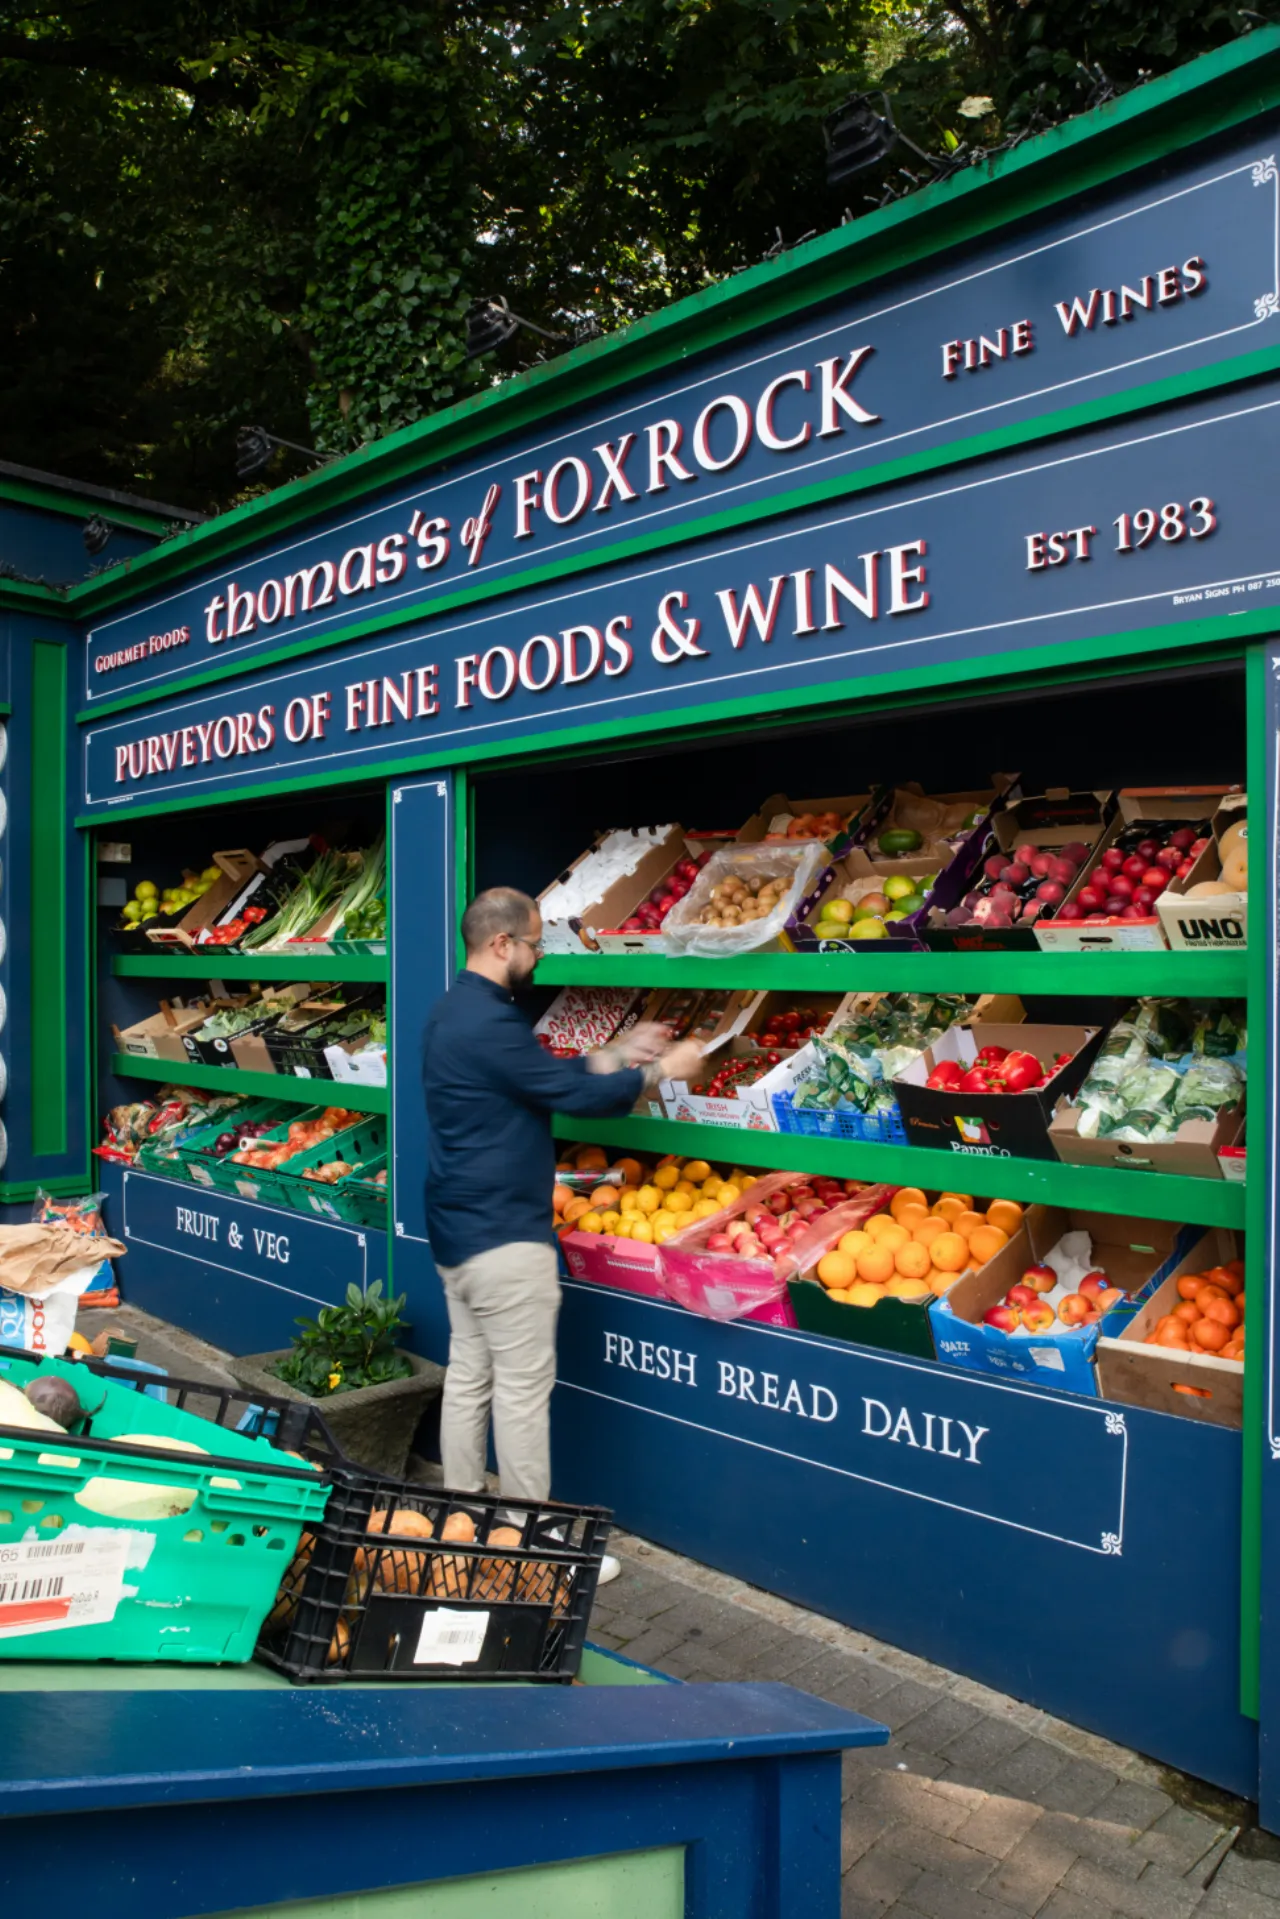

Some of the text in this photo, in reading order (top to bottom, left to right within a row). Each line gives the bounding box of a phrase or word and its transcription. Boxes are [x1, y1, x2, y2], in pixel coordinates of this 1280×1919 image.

[940, 255, 1208, 379] FINE WINES
[204, 345, 881, 644] thomas's of FOXROCK
[1024, 496, 1217, 571] EST 1983
[1173, 593, 1203, 605] BRYAN
[1205, 587, 1230, 599] SIGNS
[1248, 581, 1263, 591] 087
[95, 626, 191, 673] GOURMET FOODS
[115, 539, 931, 783] PURVEYORS OF FINE FOODS & WINE
[1177, 918, 1244, 939] UNO
[175, 1206, 290, 1264] FRUIT & VEG
[603, 1331, 990, 1464] FRESH BREAD DAILY
